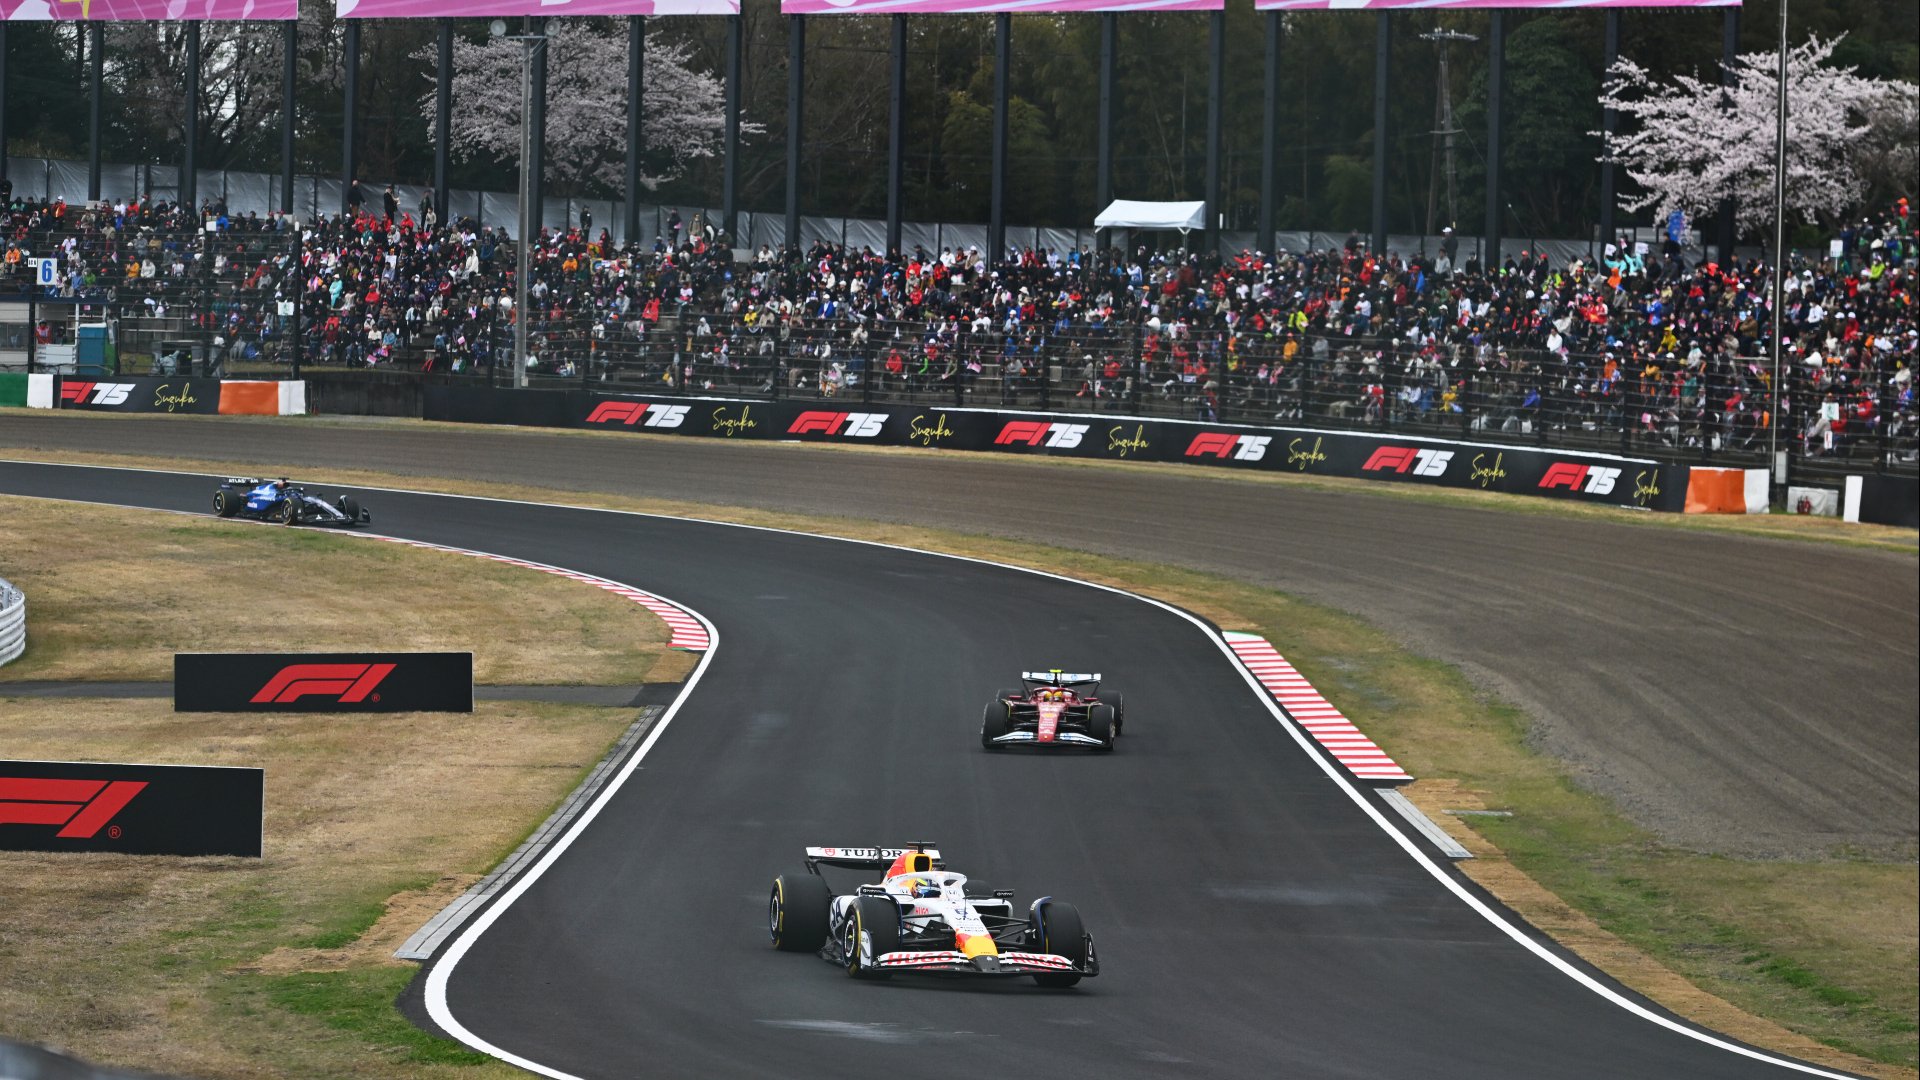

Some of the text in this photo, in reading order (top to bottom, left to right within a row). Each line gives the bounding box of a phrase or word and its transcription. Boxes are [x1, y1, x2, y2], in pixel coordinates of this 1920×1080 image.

[42, 260, 52, 282] 6
[154, 382, 197, 412] Suzuka
[712, 405, 757, 436] Suzuka
[910, 414, 954, 446] Suzuka
[1108, 424, 1149, 457] Suzuka
[1288, 436, 1327, 470] Suzuka
[1471, 452, 1507, 487] Suzuka
[249, 663, 397, 703] F1
[841, 849, 902, 858] TUDOR
[887, 951, 953, 965] HUGO
[1011, 952, 1067, 968] HUGO
